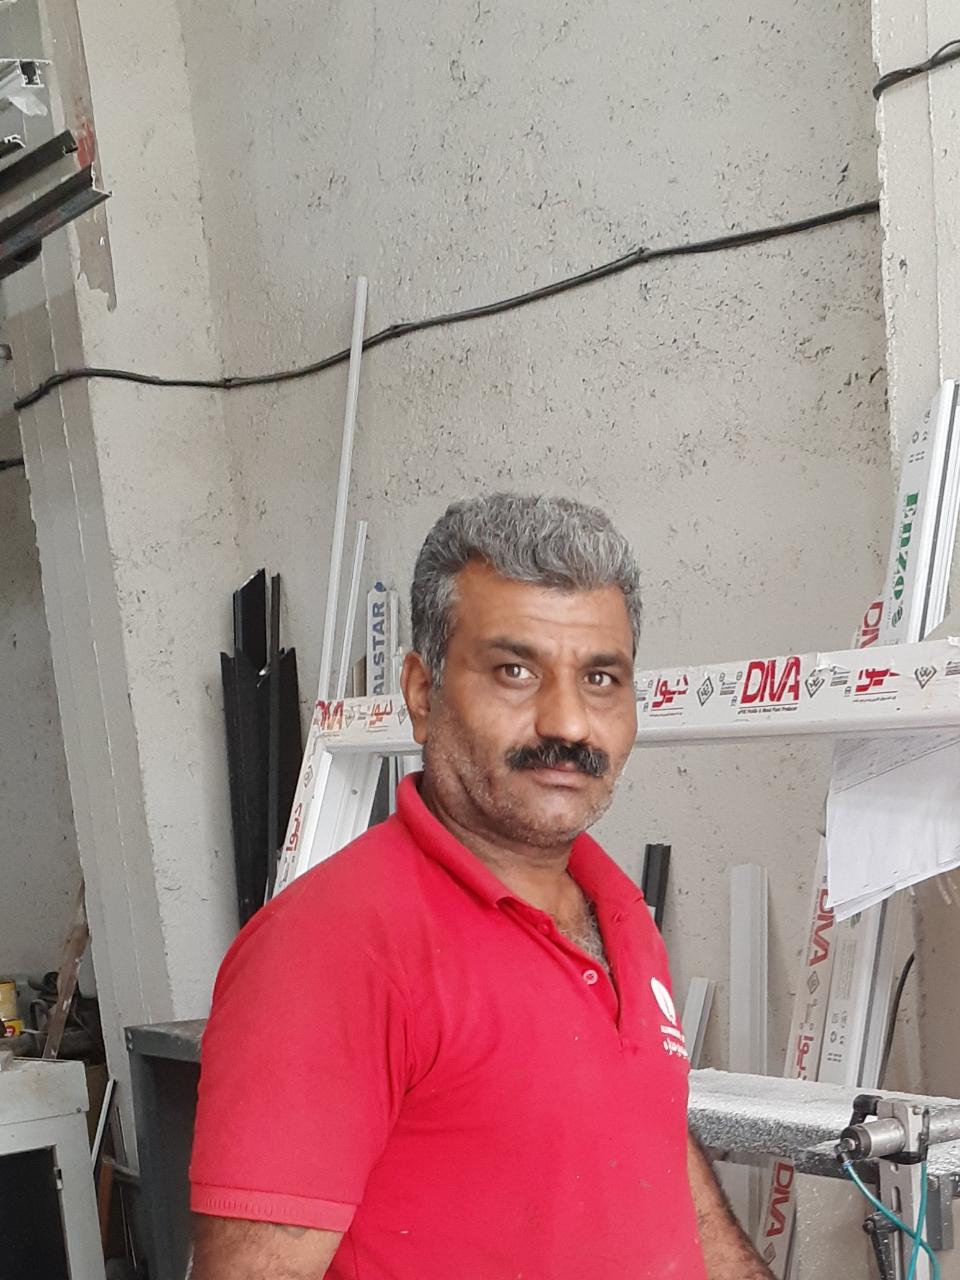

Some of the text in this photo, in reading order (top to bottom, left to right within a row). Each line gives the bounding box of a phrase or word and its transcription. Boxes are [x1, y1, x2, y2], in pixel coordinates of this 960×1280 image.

[372, 601, 385, 696] ALSTAR
[739, 656, 802, 705] DIVA
[766, 1161, 795, 1237] DIVA
